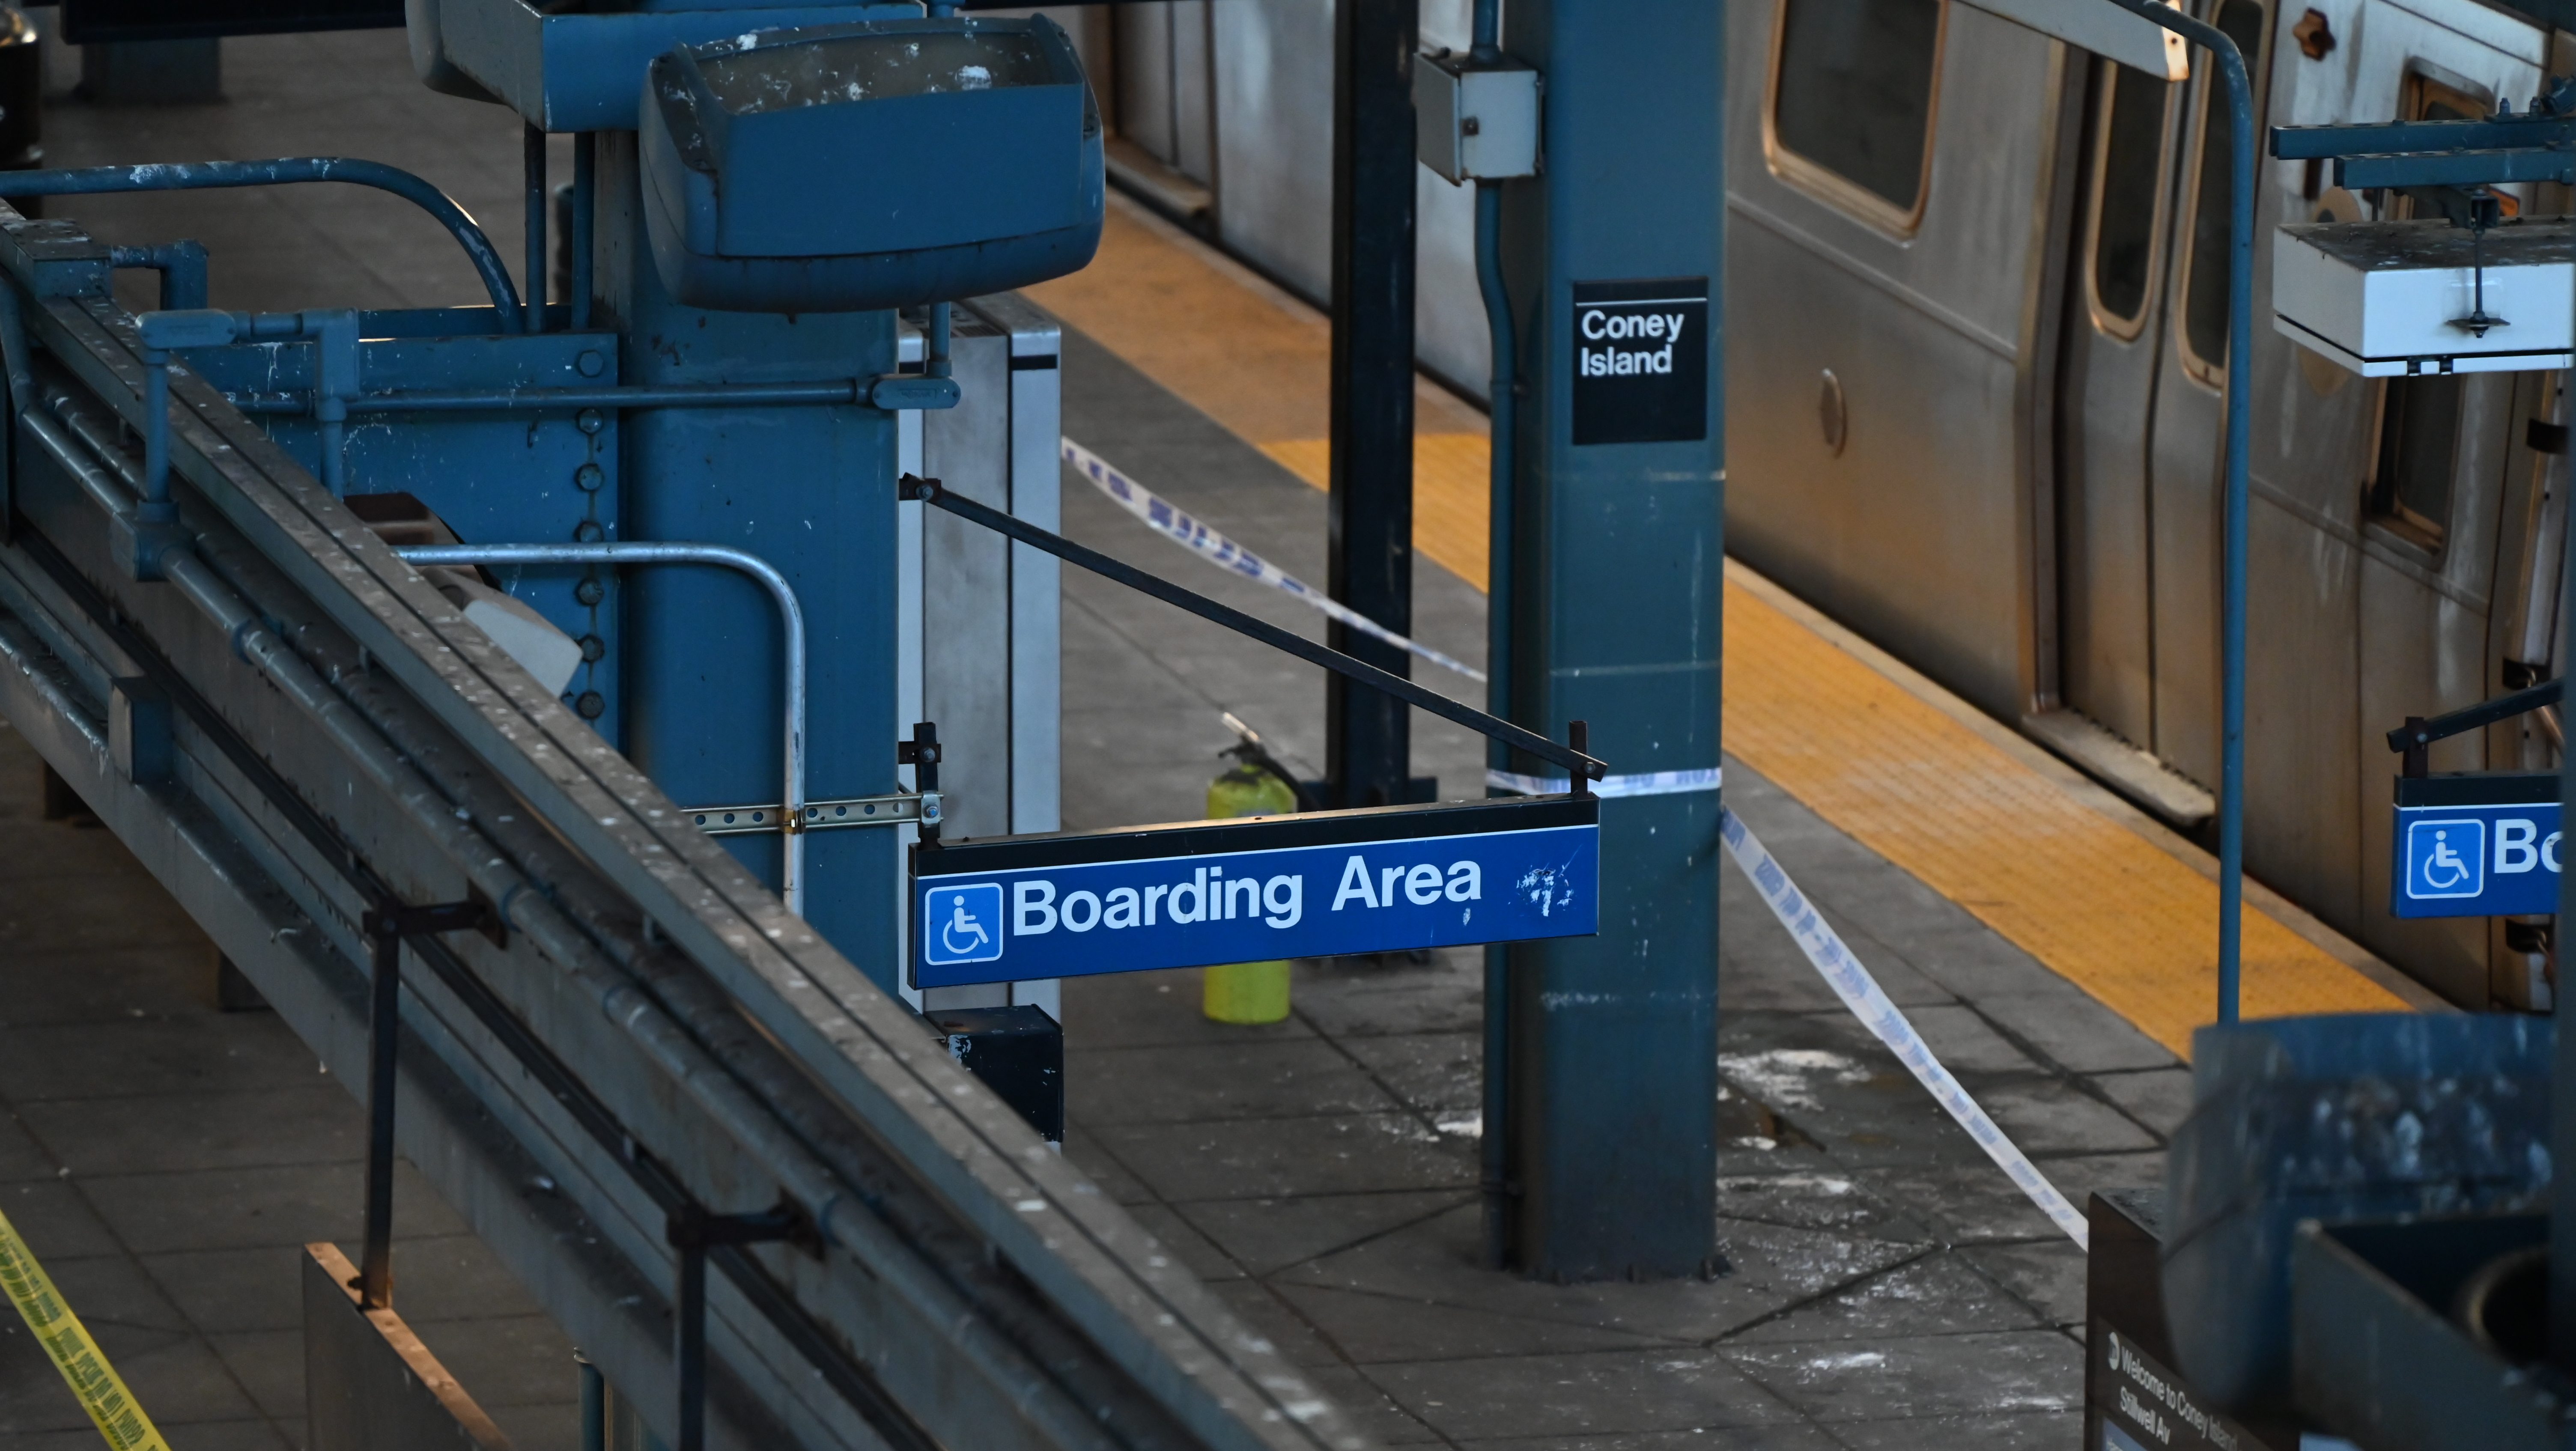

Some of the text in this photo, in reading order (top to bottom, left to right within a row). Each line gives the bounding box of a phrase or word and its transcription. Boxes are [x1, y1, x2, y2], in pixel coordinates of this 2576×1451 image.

[1582, 310, 1685, 343] Coney
[1581, 344, 1673, 376] Island
[1013, 855, 1482, 936] Boarding Area
[2120, 1385, 2171, 1445] Stillwell Av
[2121, 1346, 2165, 1401] Welcome
[2166, 1383, 2176, 1410] to
[2177, 1391, 2209, 1439] Coney
